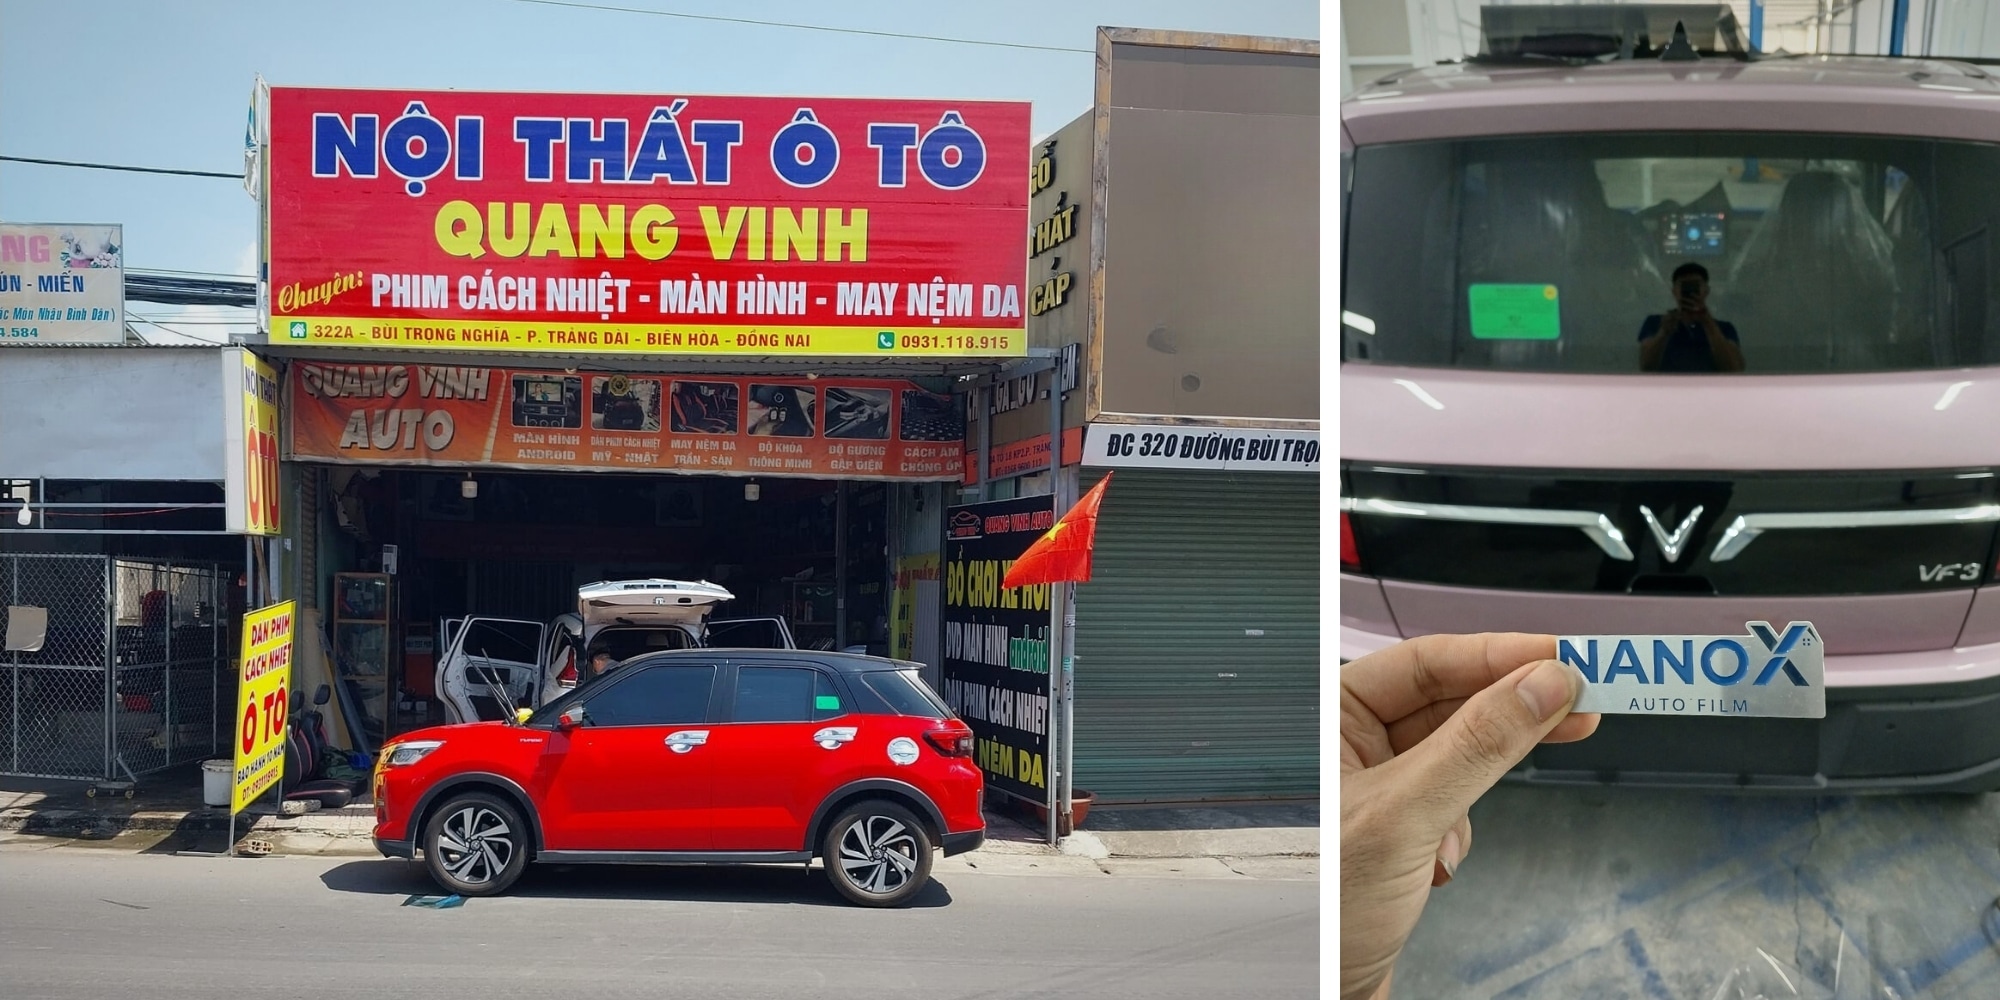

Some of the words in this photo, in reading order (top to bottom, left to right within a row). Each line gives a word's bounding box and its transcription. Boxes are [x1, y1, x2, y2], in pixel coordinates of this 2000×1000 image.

[312, 100, 484, 197] NỘI
[513, 98, 743, 184] THẤT
[770, 107, 840, 188] Ô
[868, 110, 987, 190] TÔ
[434, 199, 679, 262] QUANG
[699, 205, 869, 262] VINH
[38, 270, 84, 293] MIẾN
[1031, 258, 1071, 316] CẤP
[278, 270, 363, 313] Chuyên:
[371, 273, 448, 309] PHIM
[458, 268, 536, 311] CÁCH
[546, 271, 631, 320] NHIỆT
[638, 294, 651, 303] -
[659, 272, 728, 315] MÀN
[736, 273, 806, 315] HÌNH
[815, 297, 827, 305] -
[836, 282, 899, 316] MAY
[906, 275, 973, 324] NỆM
[982, 284, 1021, 318] DA
[13, 307, 34, 320] Món
[38, 307, 62, 324] Nhậu
[66, 307, 87, 321] Bình
[314, 325, 353, 338] 322A
[372, 323, 398, 339] BÙI
[403, 326, 455, 344] TRỌNG
[461, 326, 510, 342] NGHĨA
[527, 330, 542, 343] P.
[603, 329, 629, 345] DÀI
[646, 330, 682, 346] BIÊN
[688, 330, 719, 346] HÒA
[735, 329, 779, 347] ĐỒNG
[784, 334, 810, 347] NAI
[901, 335, 1009, 349] 0931.118.915
[302, 365, 410, 399] QUANG
[417, 365, 491, 401] VINH
[339, 408, 455, 451] AUTO
[513, 433, 545, 444] MÀN
[548, 433, 580, 445] HÌNH
[623, 436, 641, 448] CÁCH
[671, 440, 692, 450] MAY
[696, 438, 719, 451] NỆM
[722, 441, 736, 451] DA
[758, 442, 772, 453] ĐỘ
[829, 444, 844, 456] ĐỘ
[847, 444, 886, 456] GƯƠNG
[904, 445, 936, 458] CÁCH
[939, 445, 959, 458] ÂM
[1107, 433, 1135, 457] ĐC
[1139, 432, 1178, 457] 320
[1179, 431, 1245, 461] ĐƯỜNG
[1246, 434, 1280, 462] BÙI
[1282, 438, 1320, 467] TRỌ
[517, 449, 576, 461] ANDROID
[592, 449, 611, 461] MỸ
[625, 452, 659, 465] NHẬT
[711, 453, 732, 466] SÀN
[748, 455, 782, 468] THÔNG
[785, 458, 812, 469] MINH
[830, 458, 854, 472] GẬP
[856, 458, 883, 471] ĐIỆN
[900, 459, 942, 472] CHỐNG
[985, 514, 1010, 534] QUANG
[1010, 512, 1030, 532] VINH
[1030, 509, 1053, 531] AUTO
[968, 560, 998, 608] CHƠI
[271, 613, 290, 640] PHIM
[946, 621, 962, 660] DVD
[963, 614, 983, 663] MÀN
[985, 615, 1008, 667] HÌNH
[1010, 624, 1049, 674] android
[1559, 625, 1810, 687] NANOX
[243, 690, 257, 756] Ô
[263, 677, 287, 744] TÔ
[964, 681, 987, 721] PHIM
[989, 679, 1013, 727] CÁCH
[1016, 687, 1048, 745] NHIỆT
[1629, 698, 1685, 711] AUTO
[1697, 698, 1749, 713] FILM
[979, 735, 1014, 781] NỆM
[1019, 749, 1045, 789] DA
